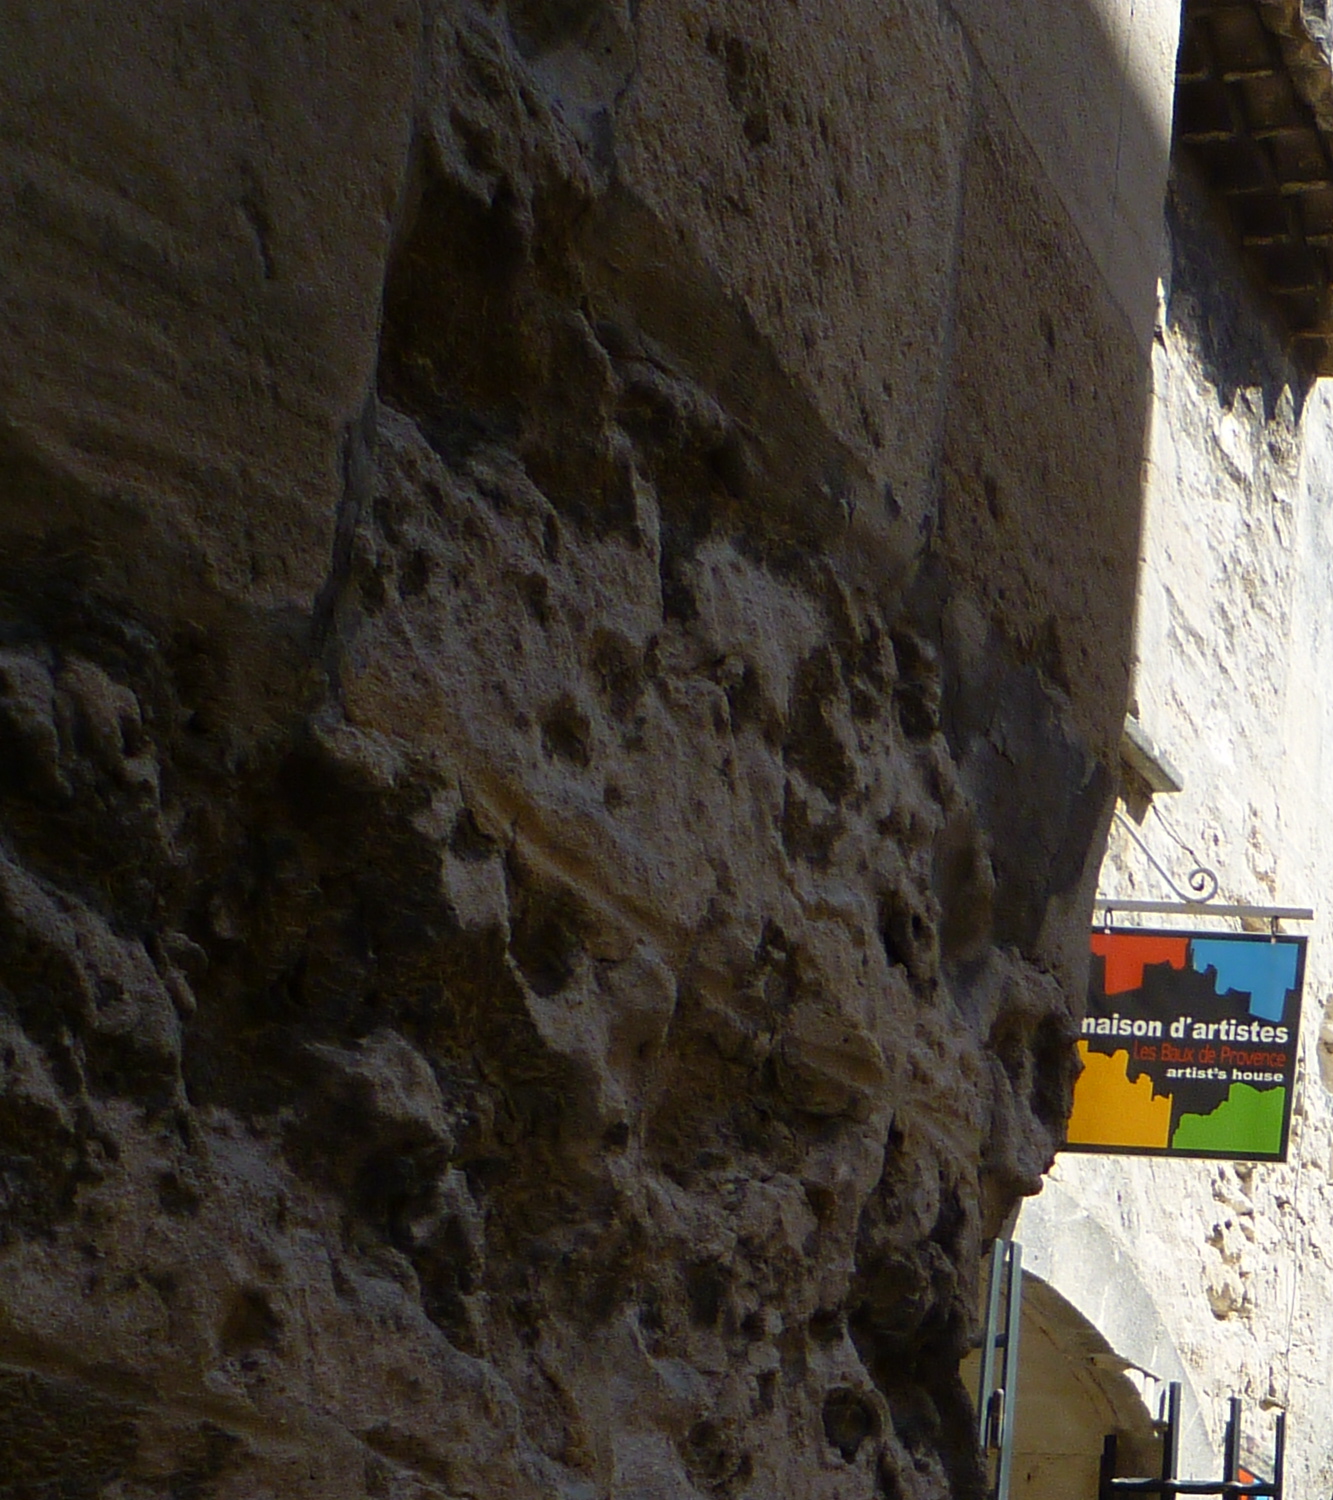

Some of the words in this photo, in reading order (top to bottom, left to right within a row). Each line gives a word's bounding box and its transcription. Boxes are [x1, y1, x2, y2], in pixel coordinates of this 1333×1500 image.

[1170, 1016, 1289, 1044] d'artistes
[1133, 1040, 1156, 1061] Les
[1161, 1043, 1194, 1063] Baux
[1199, 1044, 1216, 1064] de
[1220, 1046, 1287, 1068] Provence
[1166, 1067, 1227, 1080] artist's
[1232, 1069, 1284, 1082] house
